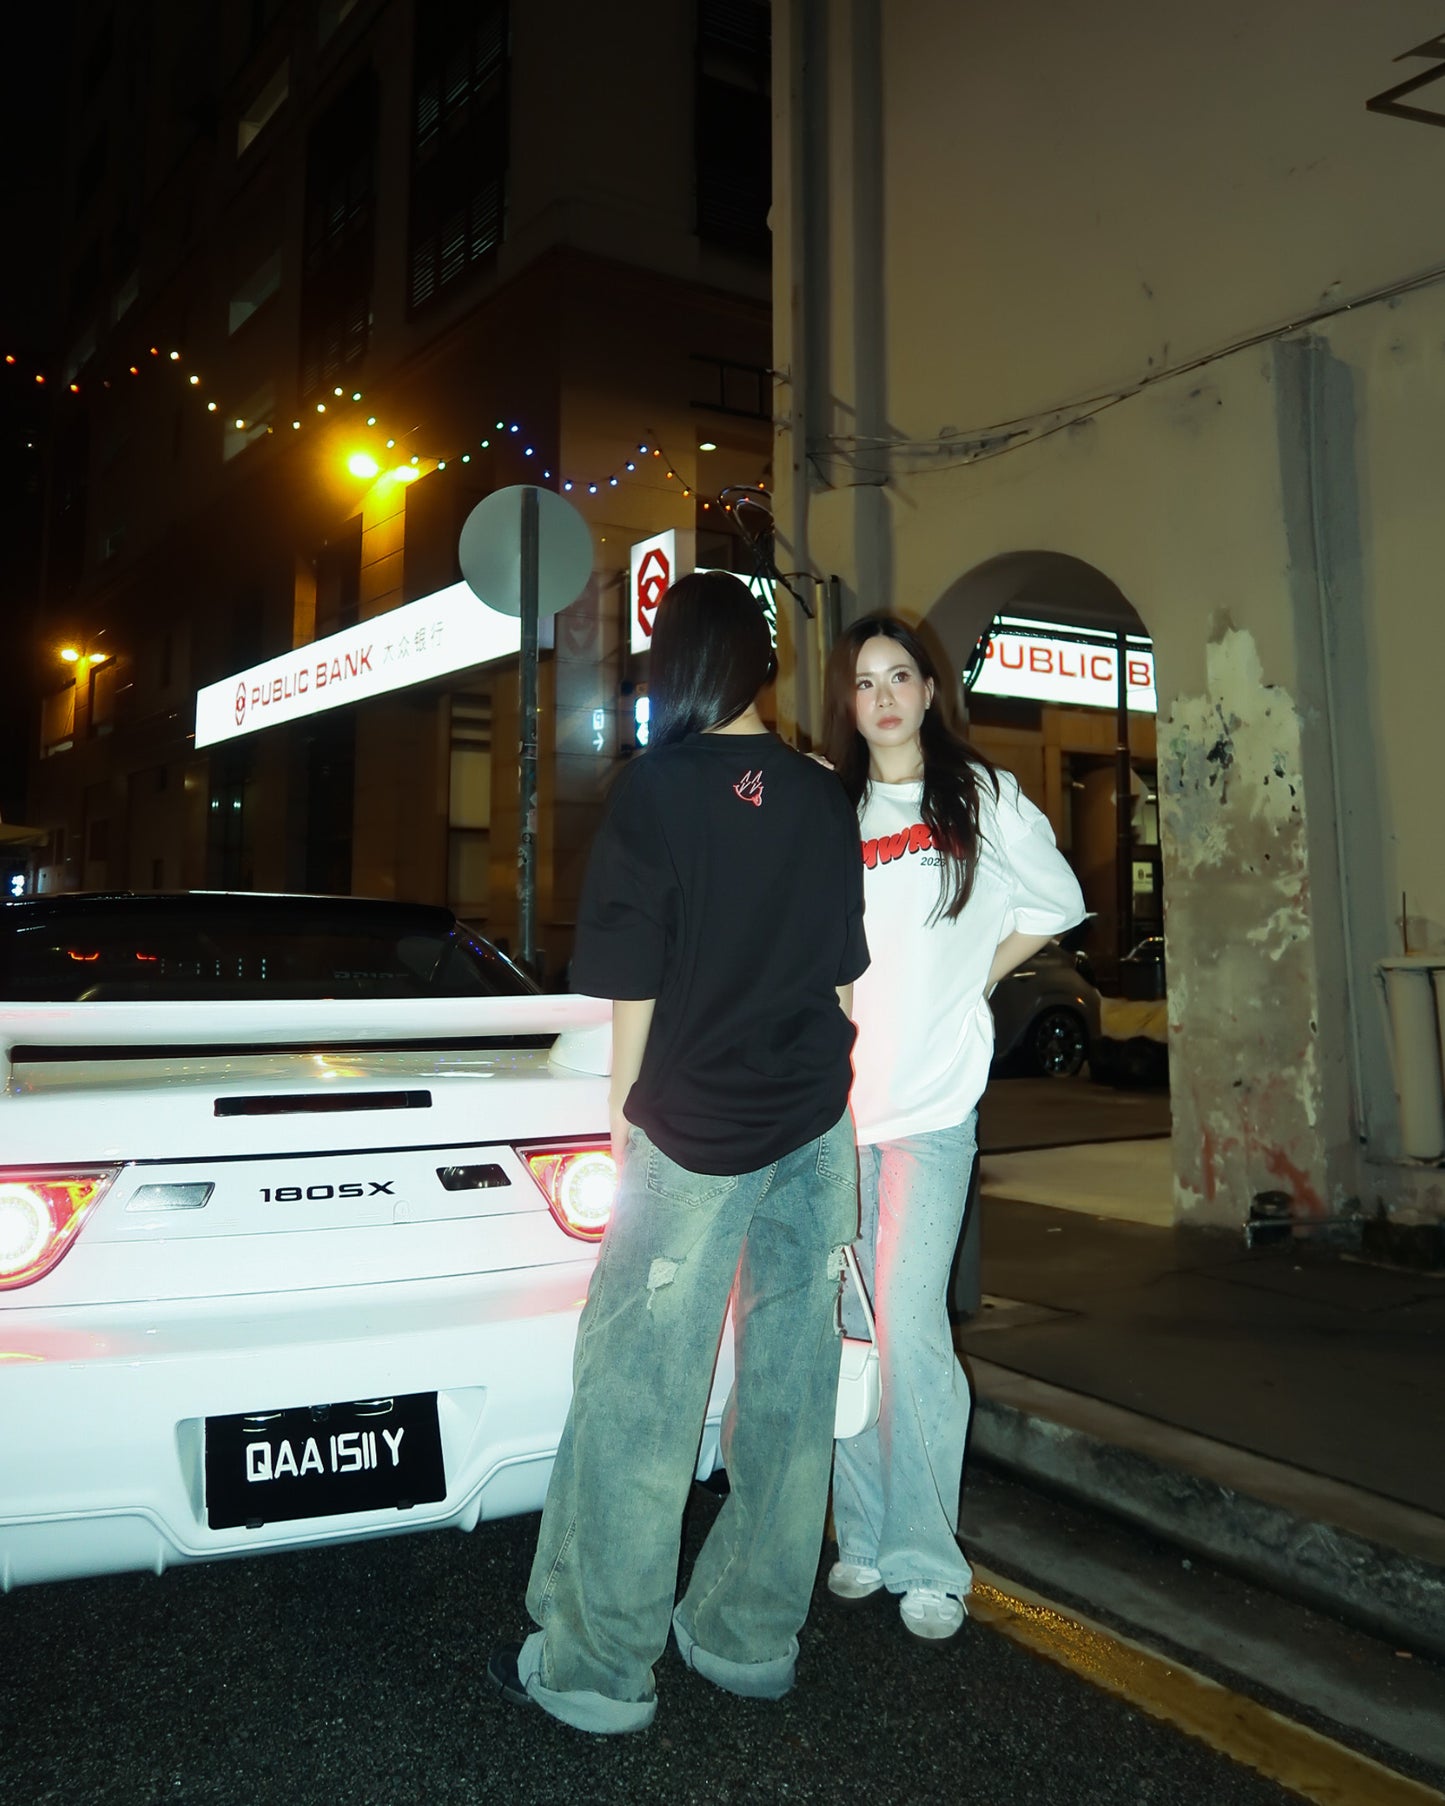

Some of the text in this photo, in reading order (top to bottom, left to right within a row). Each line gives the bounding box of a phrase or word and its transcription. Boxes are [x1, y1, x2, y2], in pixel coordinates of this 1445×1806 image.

[251, 645, 374, 711] PUBLIC BANK
[259, 1180, 395, 1203] 180SX
[246, 1437, 324, 1482] QAA
[382, 1427, 404, 1467] Y
